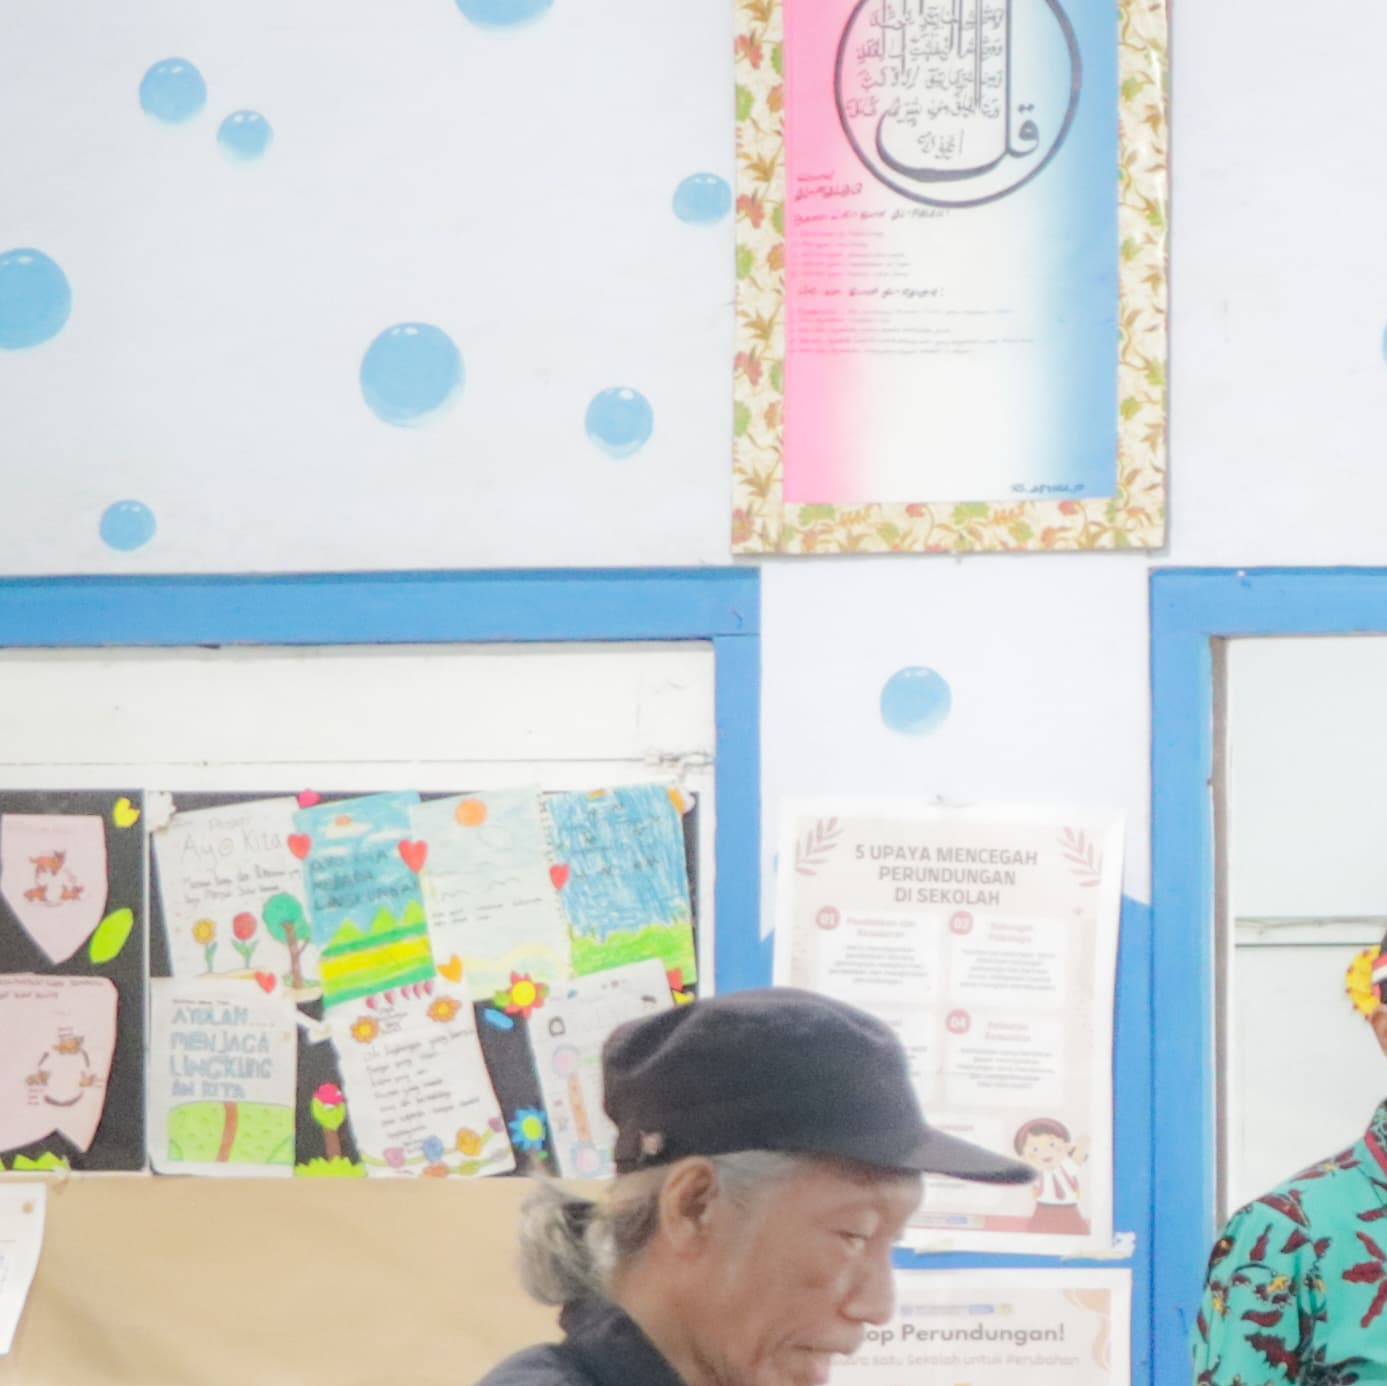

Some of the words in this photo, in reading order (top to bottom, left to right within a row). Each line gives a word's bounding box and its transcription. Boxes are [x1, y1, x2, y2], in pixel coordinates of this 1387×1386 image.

[869, 844, 931, 862] UPAYA
[936, 847, 1039, 865] MENCEGAH
[878, 866, 1017, 885] PERUNDUNGAN
[894, 887, 912, 902] DI
[916, 887, 1001, 906] SEKOLAH
[902, 1324, 1065, 1345] Perundungan!
